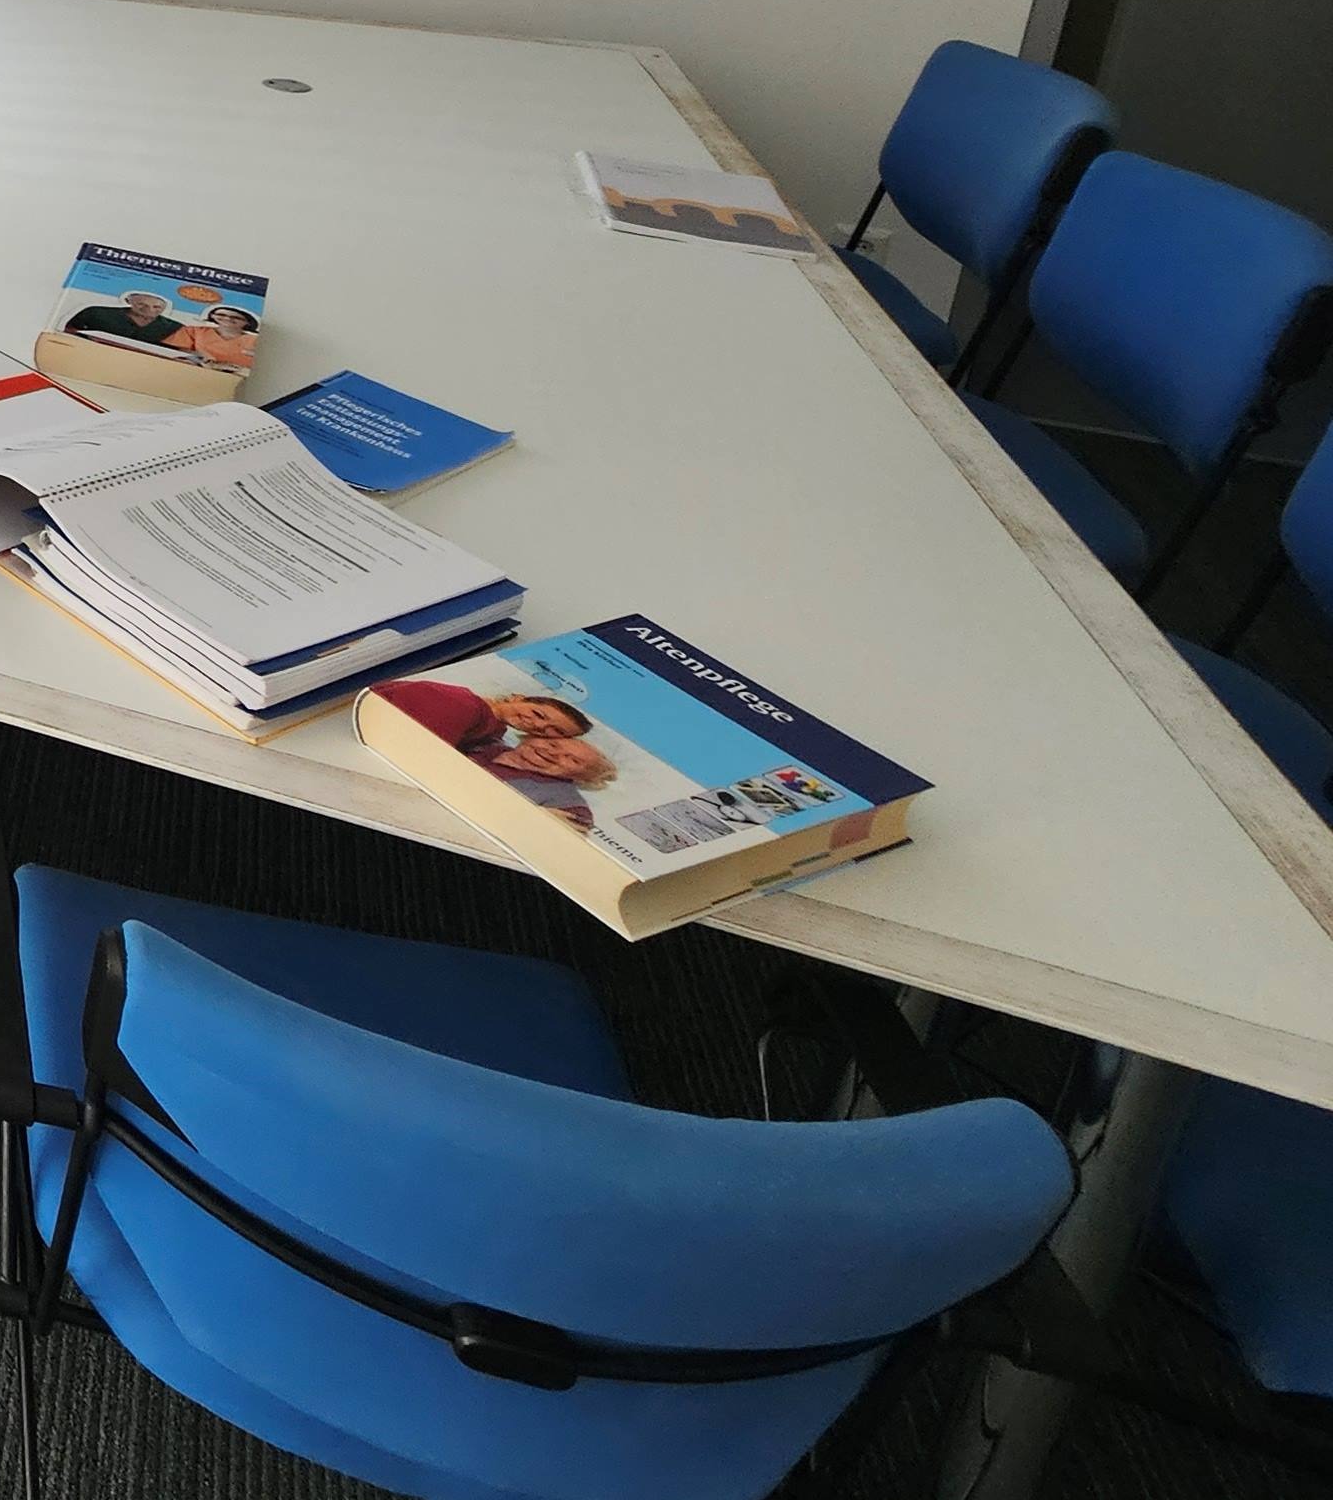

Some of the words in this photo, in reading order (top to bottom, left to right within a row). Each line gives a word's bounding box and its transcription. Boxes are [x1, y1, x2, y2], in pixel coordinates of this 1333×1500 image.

[93, 246, 182, 272] Thiemes
[187, 264, 255, 286] Pflege
[296, 407, 318, 420] im
[316, 415, 413, 459] Krankenhaus
[306, 403, 402, 446] management
[327, 393, 423, 437] Pflegerisches
[625, 624, 795, 725] Altenpflege
